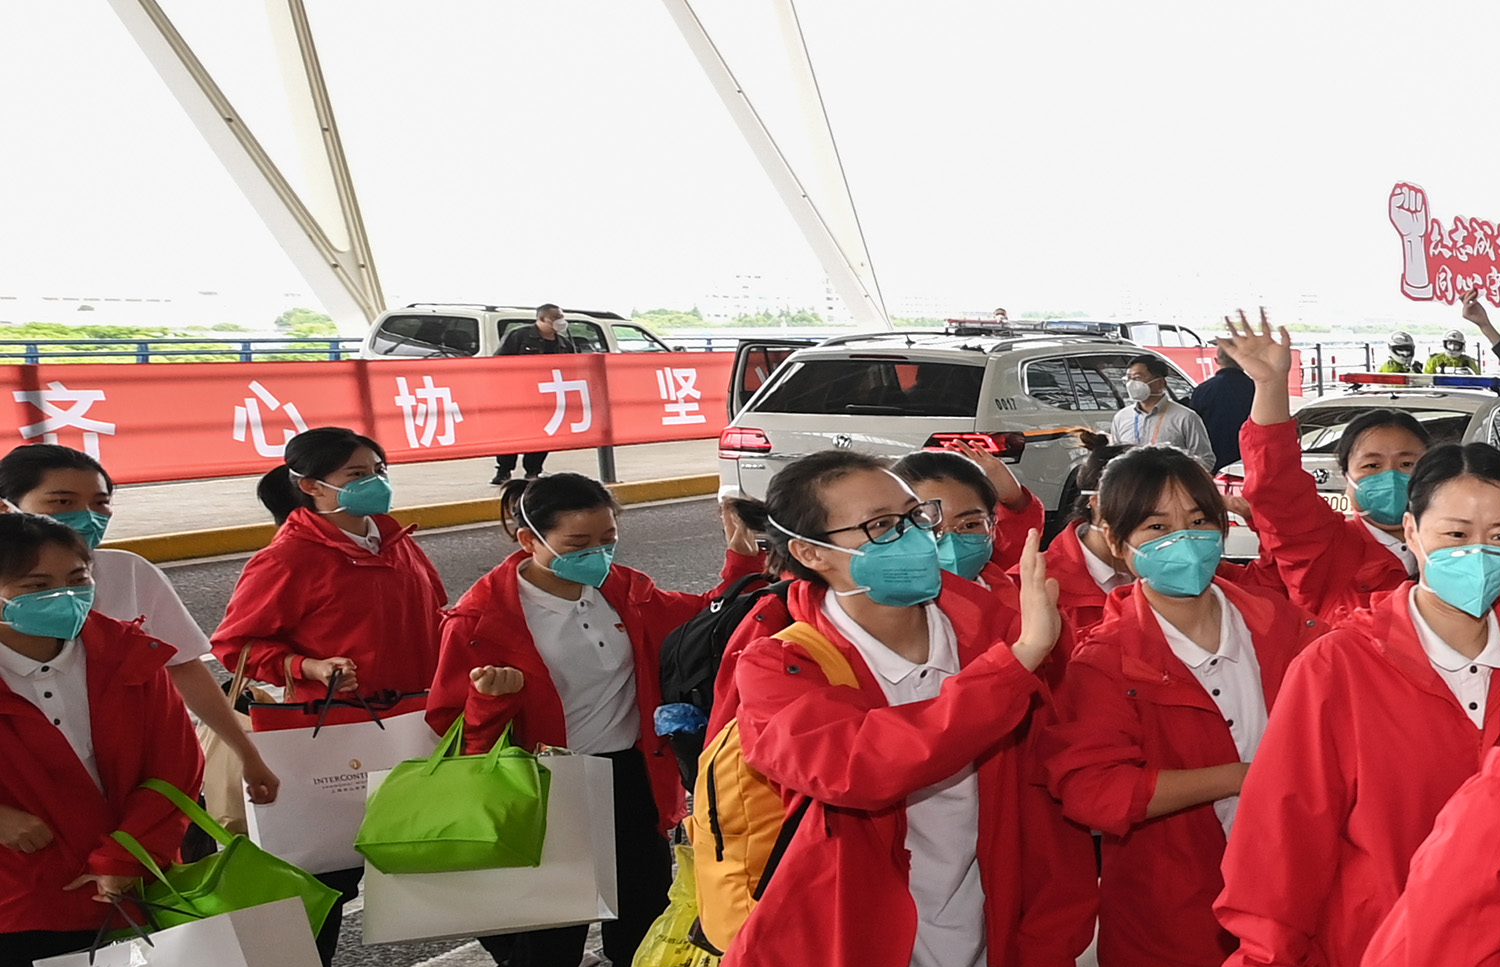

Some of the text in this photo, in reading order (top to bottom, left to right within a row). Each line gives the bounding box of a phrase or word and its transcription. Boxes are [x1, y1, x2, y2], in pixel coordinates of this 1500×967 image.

[13, 366, 707, 462] 齐心协力坚
[995, 398, 1017, 410] 0017
